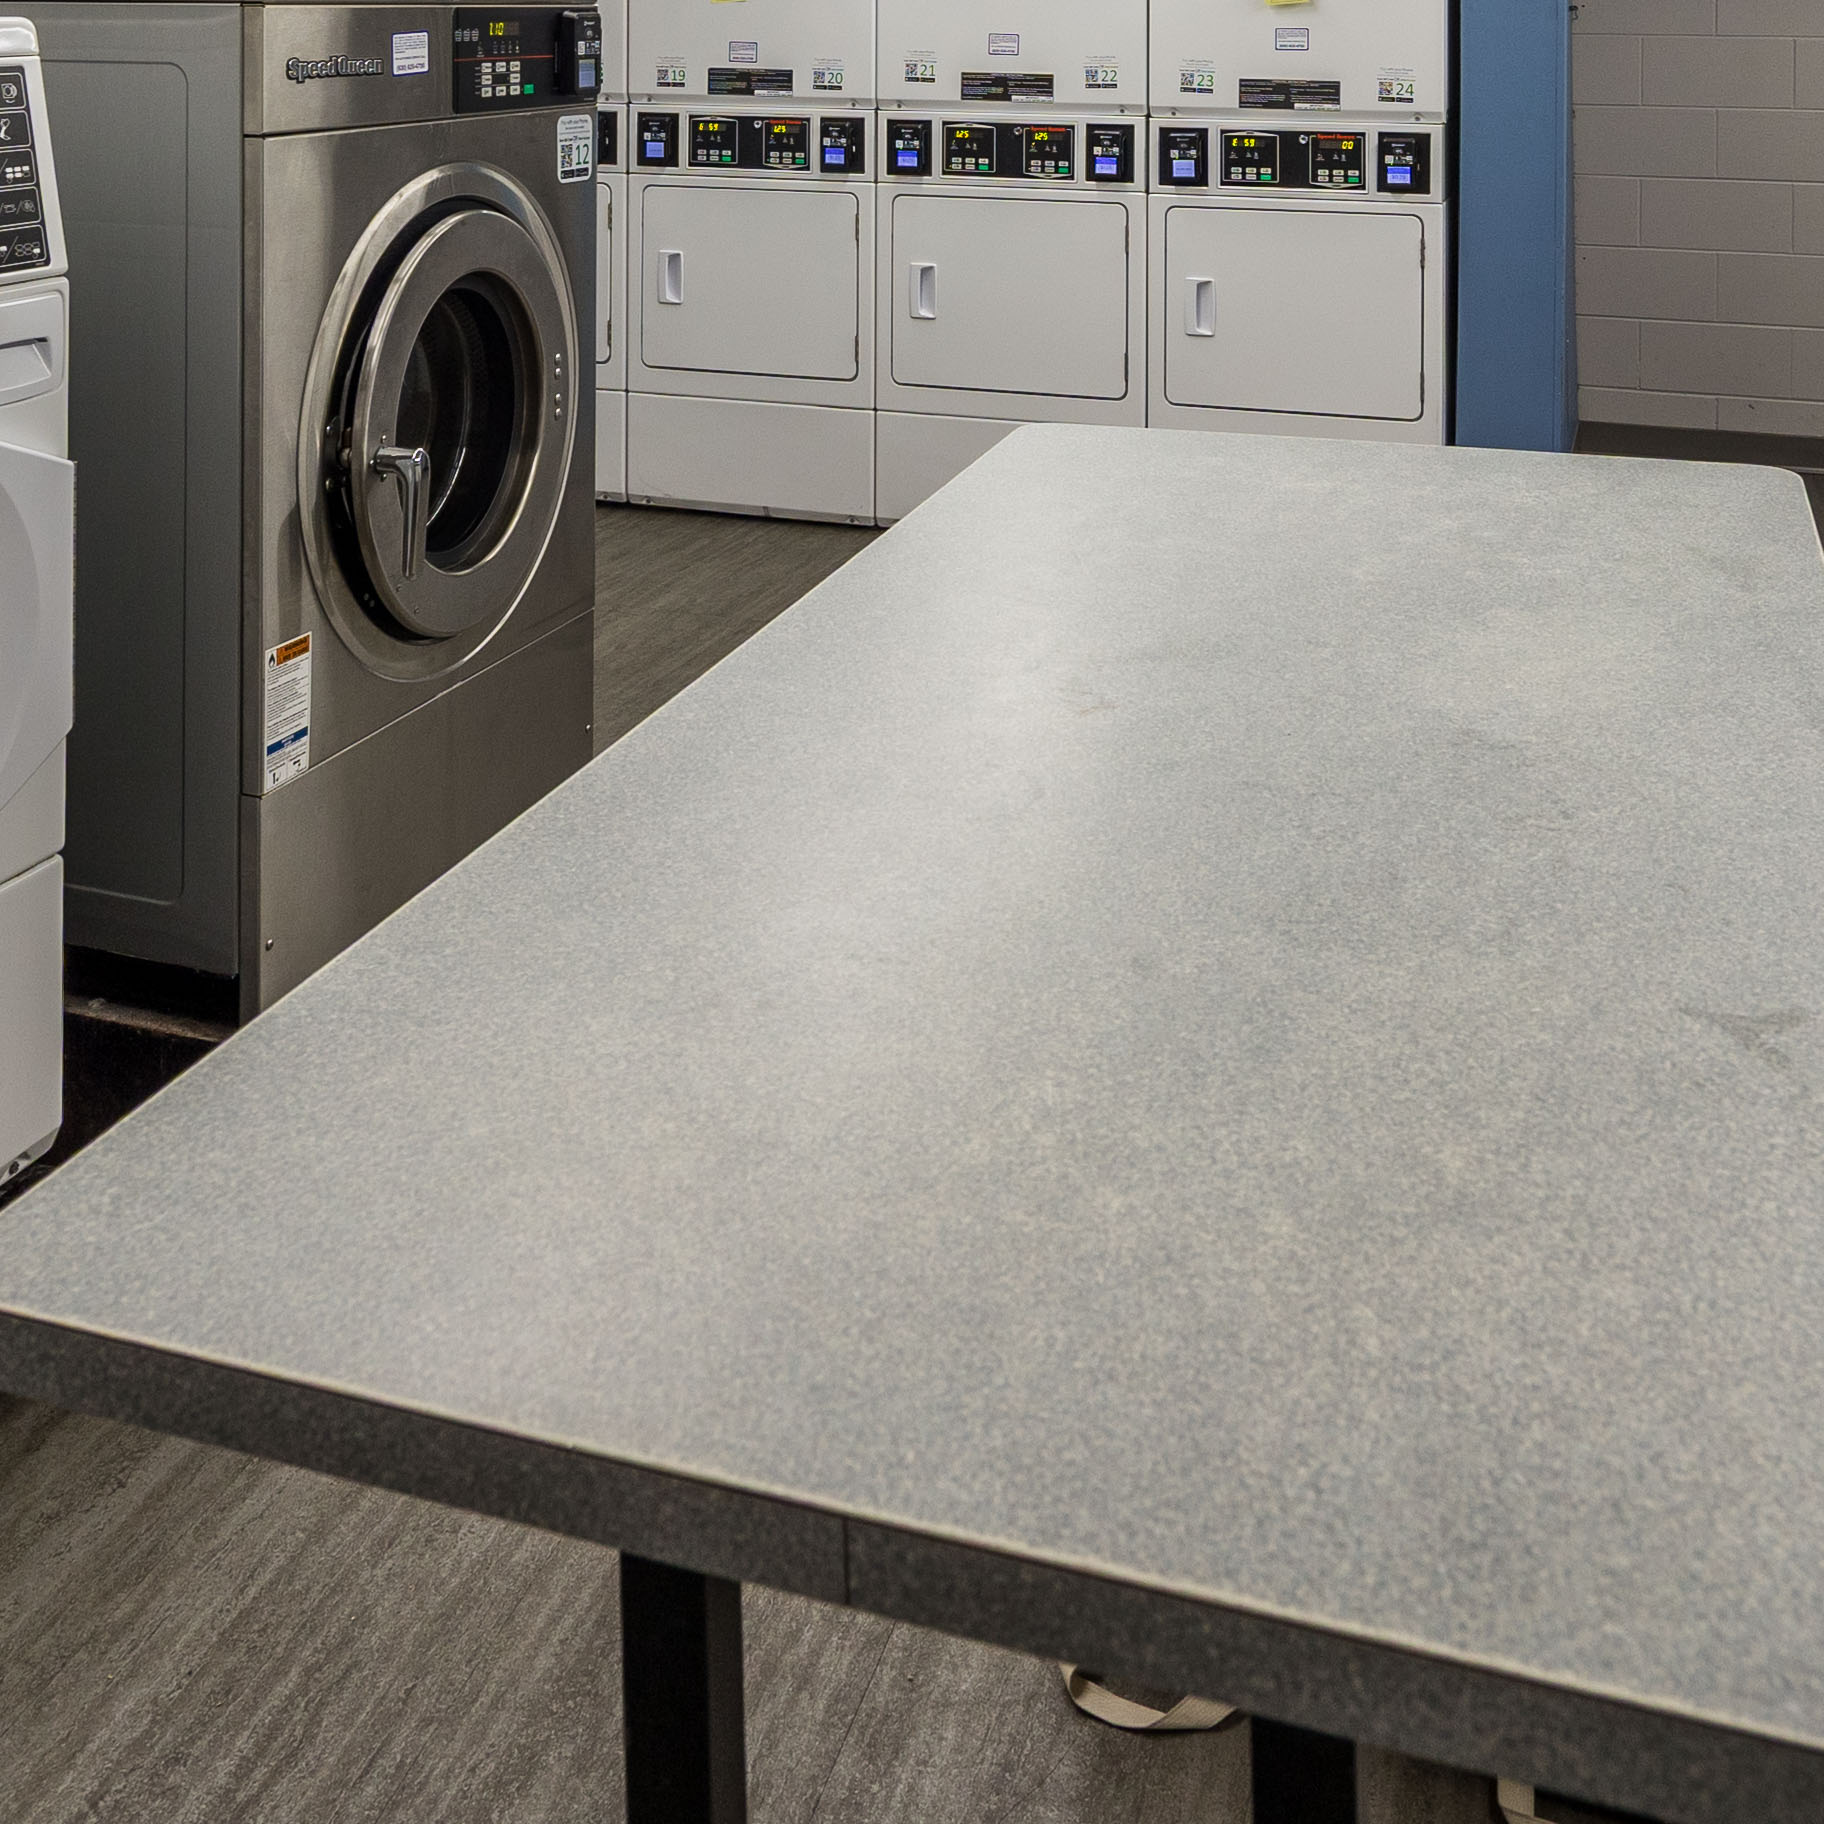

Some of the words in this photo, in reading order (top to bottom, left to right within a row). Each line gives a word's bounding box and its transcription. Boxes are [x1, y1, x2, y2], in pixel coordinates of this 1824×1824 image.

[670, 69, 686, 82] 19
[919, 64, 936, 77] 21
[1100, 69, 1118, 83] 22
[827, 71, 844, 85] 20
[1196, 74, 1214, 88] 23
[1395, 83, 1415, 97] 24
[575, 143, 590, 166] 12
